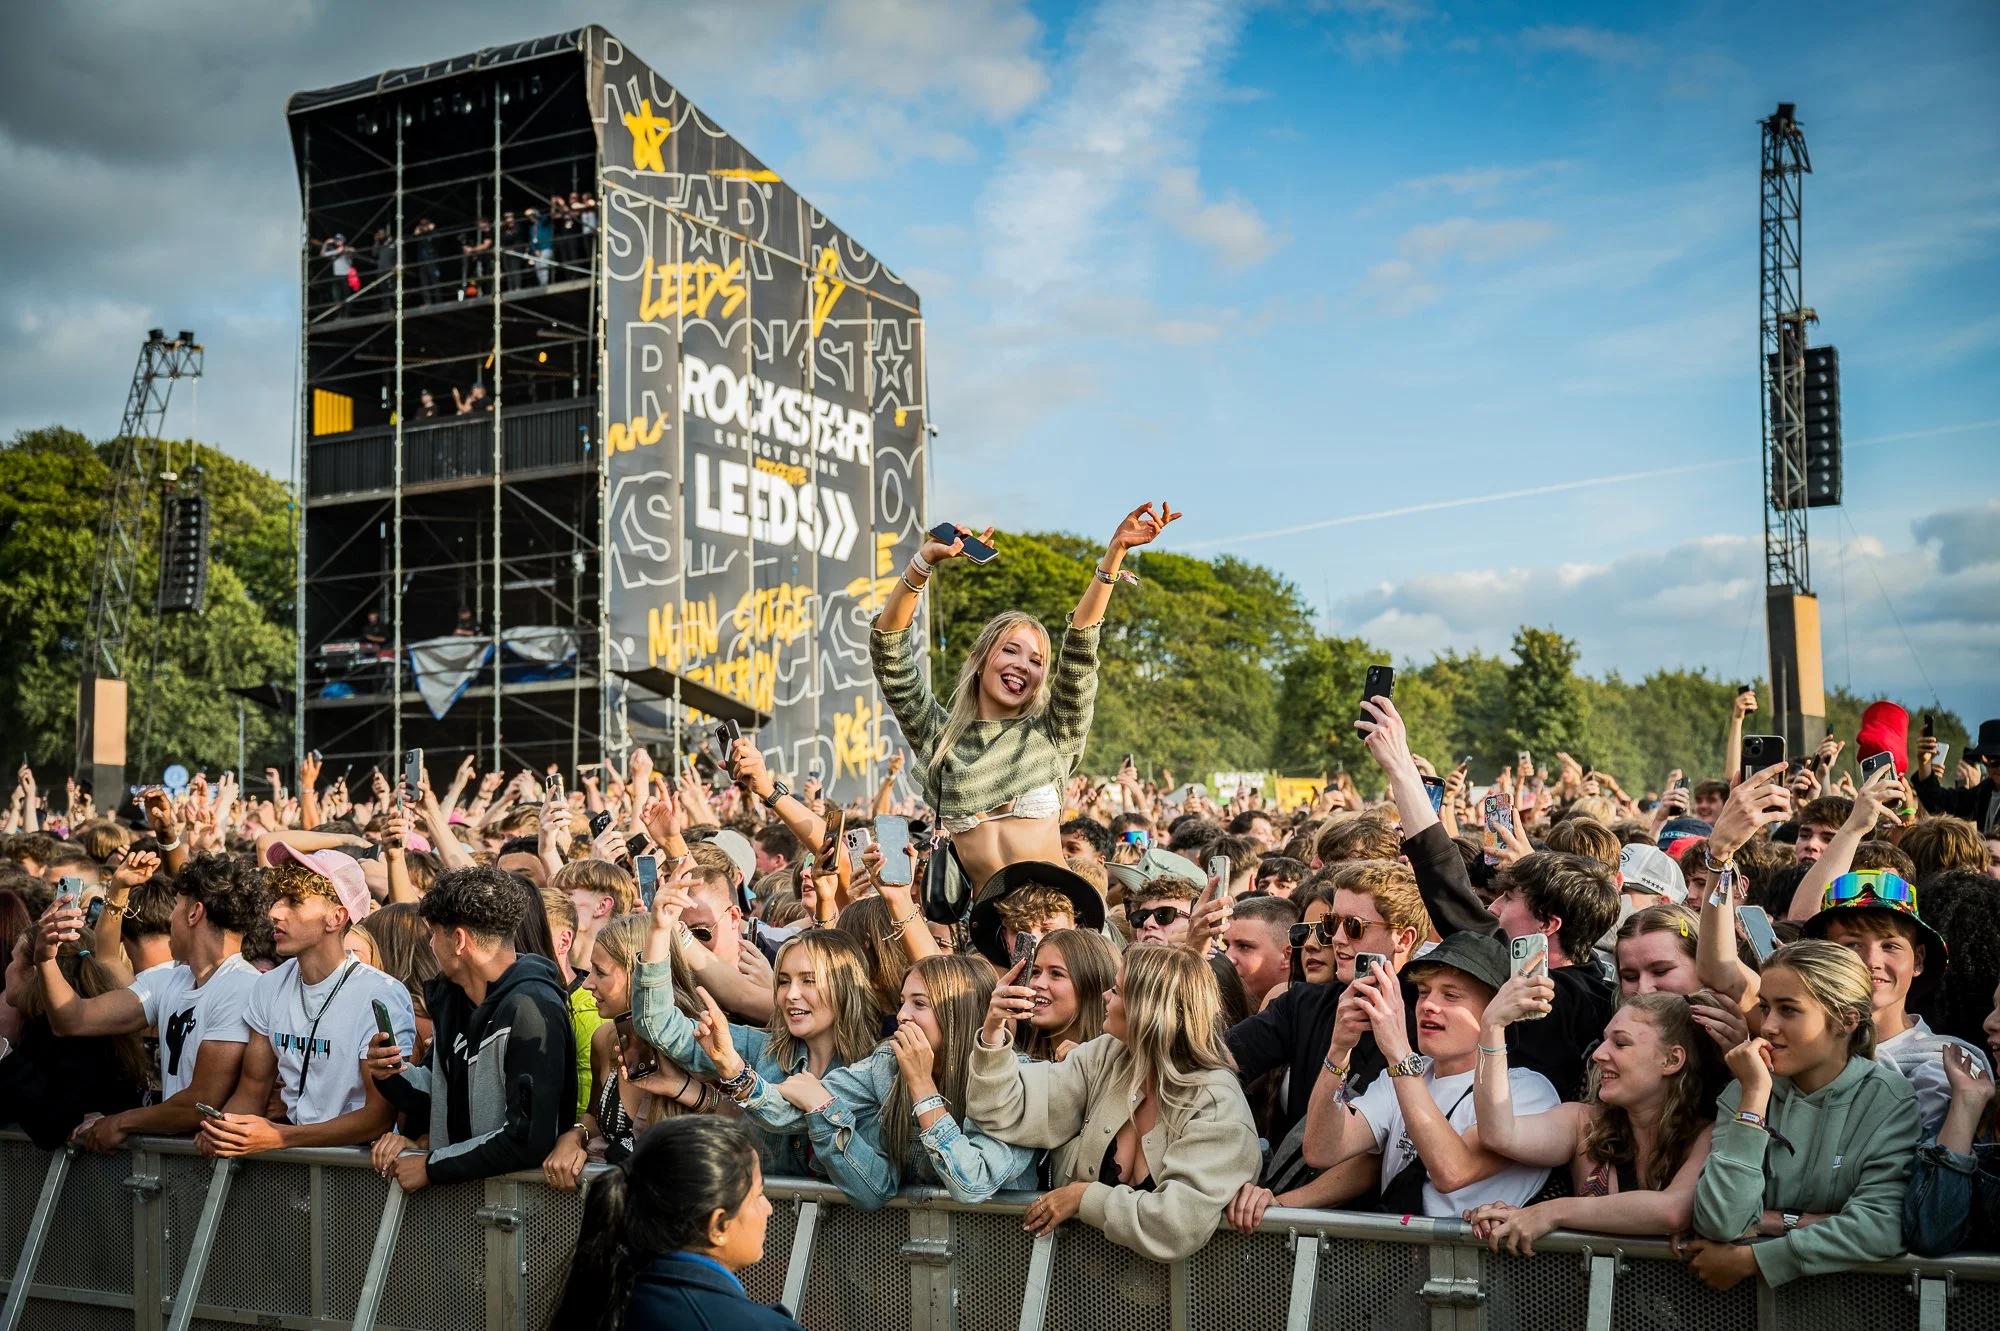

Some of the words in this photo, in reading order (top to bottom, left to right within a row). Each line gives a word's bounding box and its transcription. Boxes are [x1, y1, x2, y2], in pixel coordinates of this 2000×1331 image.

[639, 256, 747, 322] LEEDS
[683, 354, 873, 466] ROCKSTAR
[714, 428, 783, 461] ENERGY
[694, 453, 825, 552] LEEDS
[732, 582, 813, 651] STAGE
